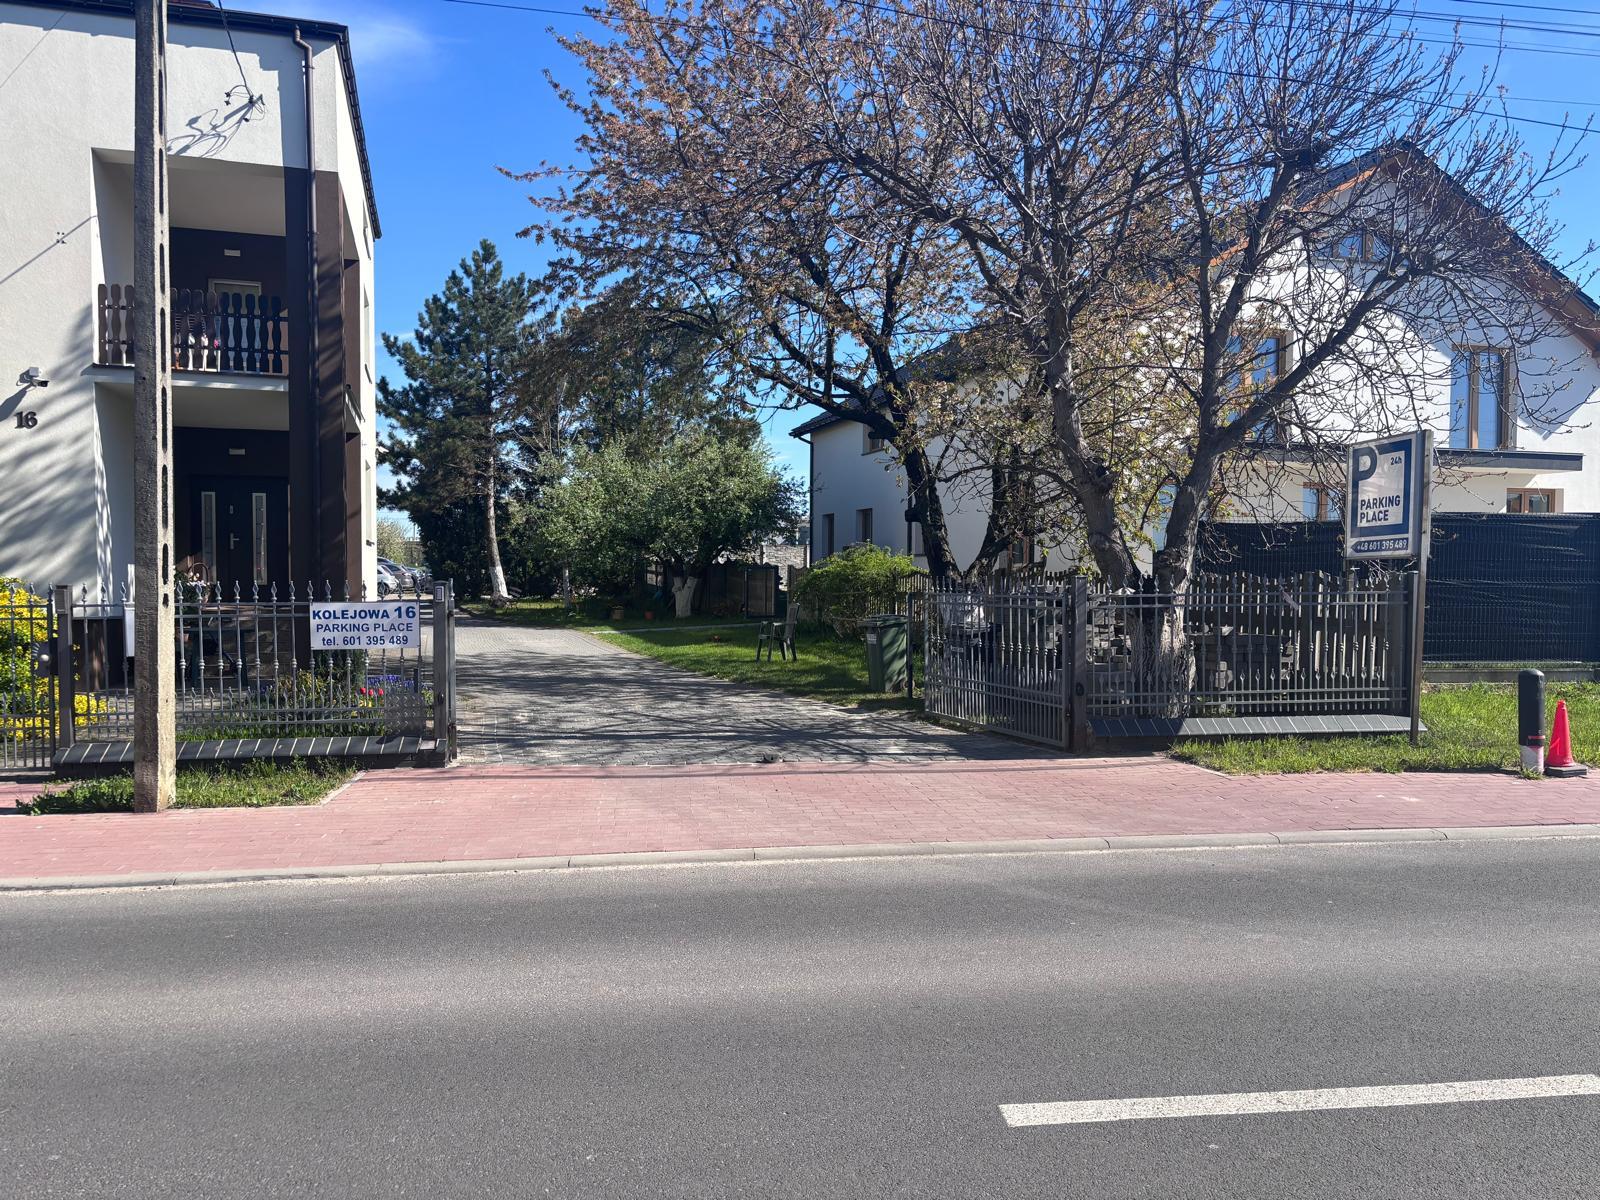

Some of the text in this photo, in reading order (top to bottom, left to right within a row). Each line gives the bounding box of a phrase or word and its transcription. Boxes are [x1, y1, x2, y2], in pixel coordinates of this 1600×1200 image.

[13, 411, 38, 429] 16
[1390, 456, 1402, 466] 24h
[1360, 495, 1401, 510] PARKING
[1360, 510, 1389, 523] PLACE
[1357, 540, 1407, 550] +48 601 395 489
[312, 606, 416, 620] KOLEJOWA 16
[316, 622, 413, 633] PARKING PLACE
[321, 635, 408, 646] tel. 601 395 489
